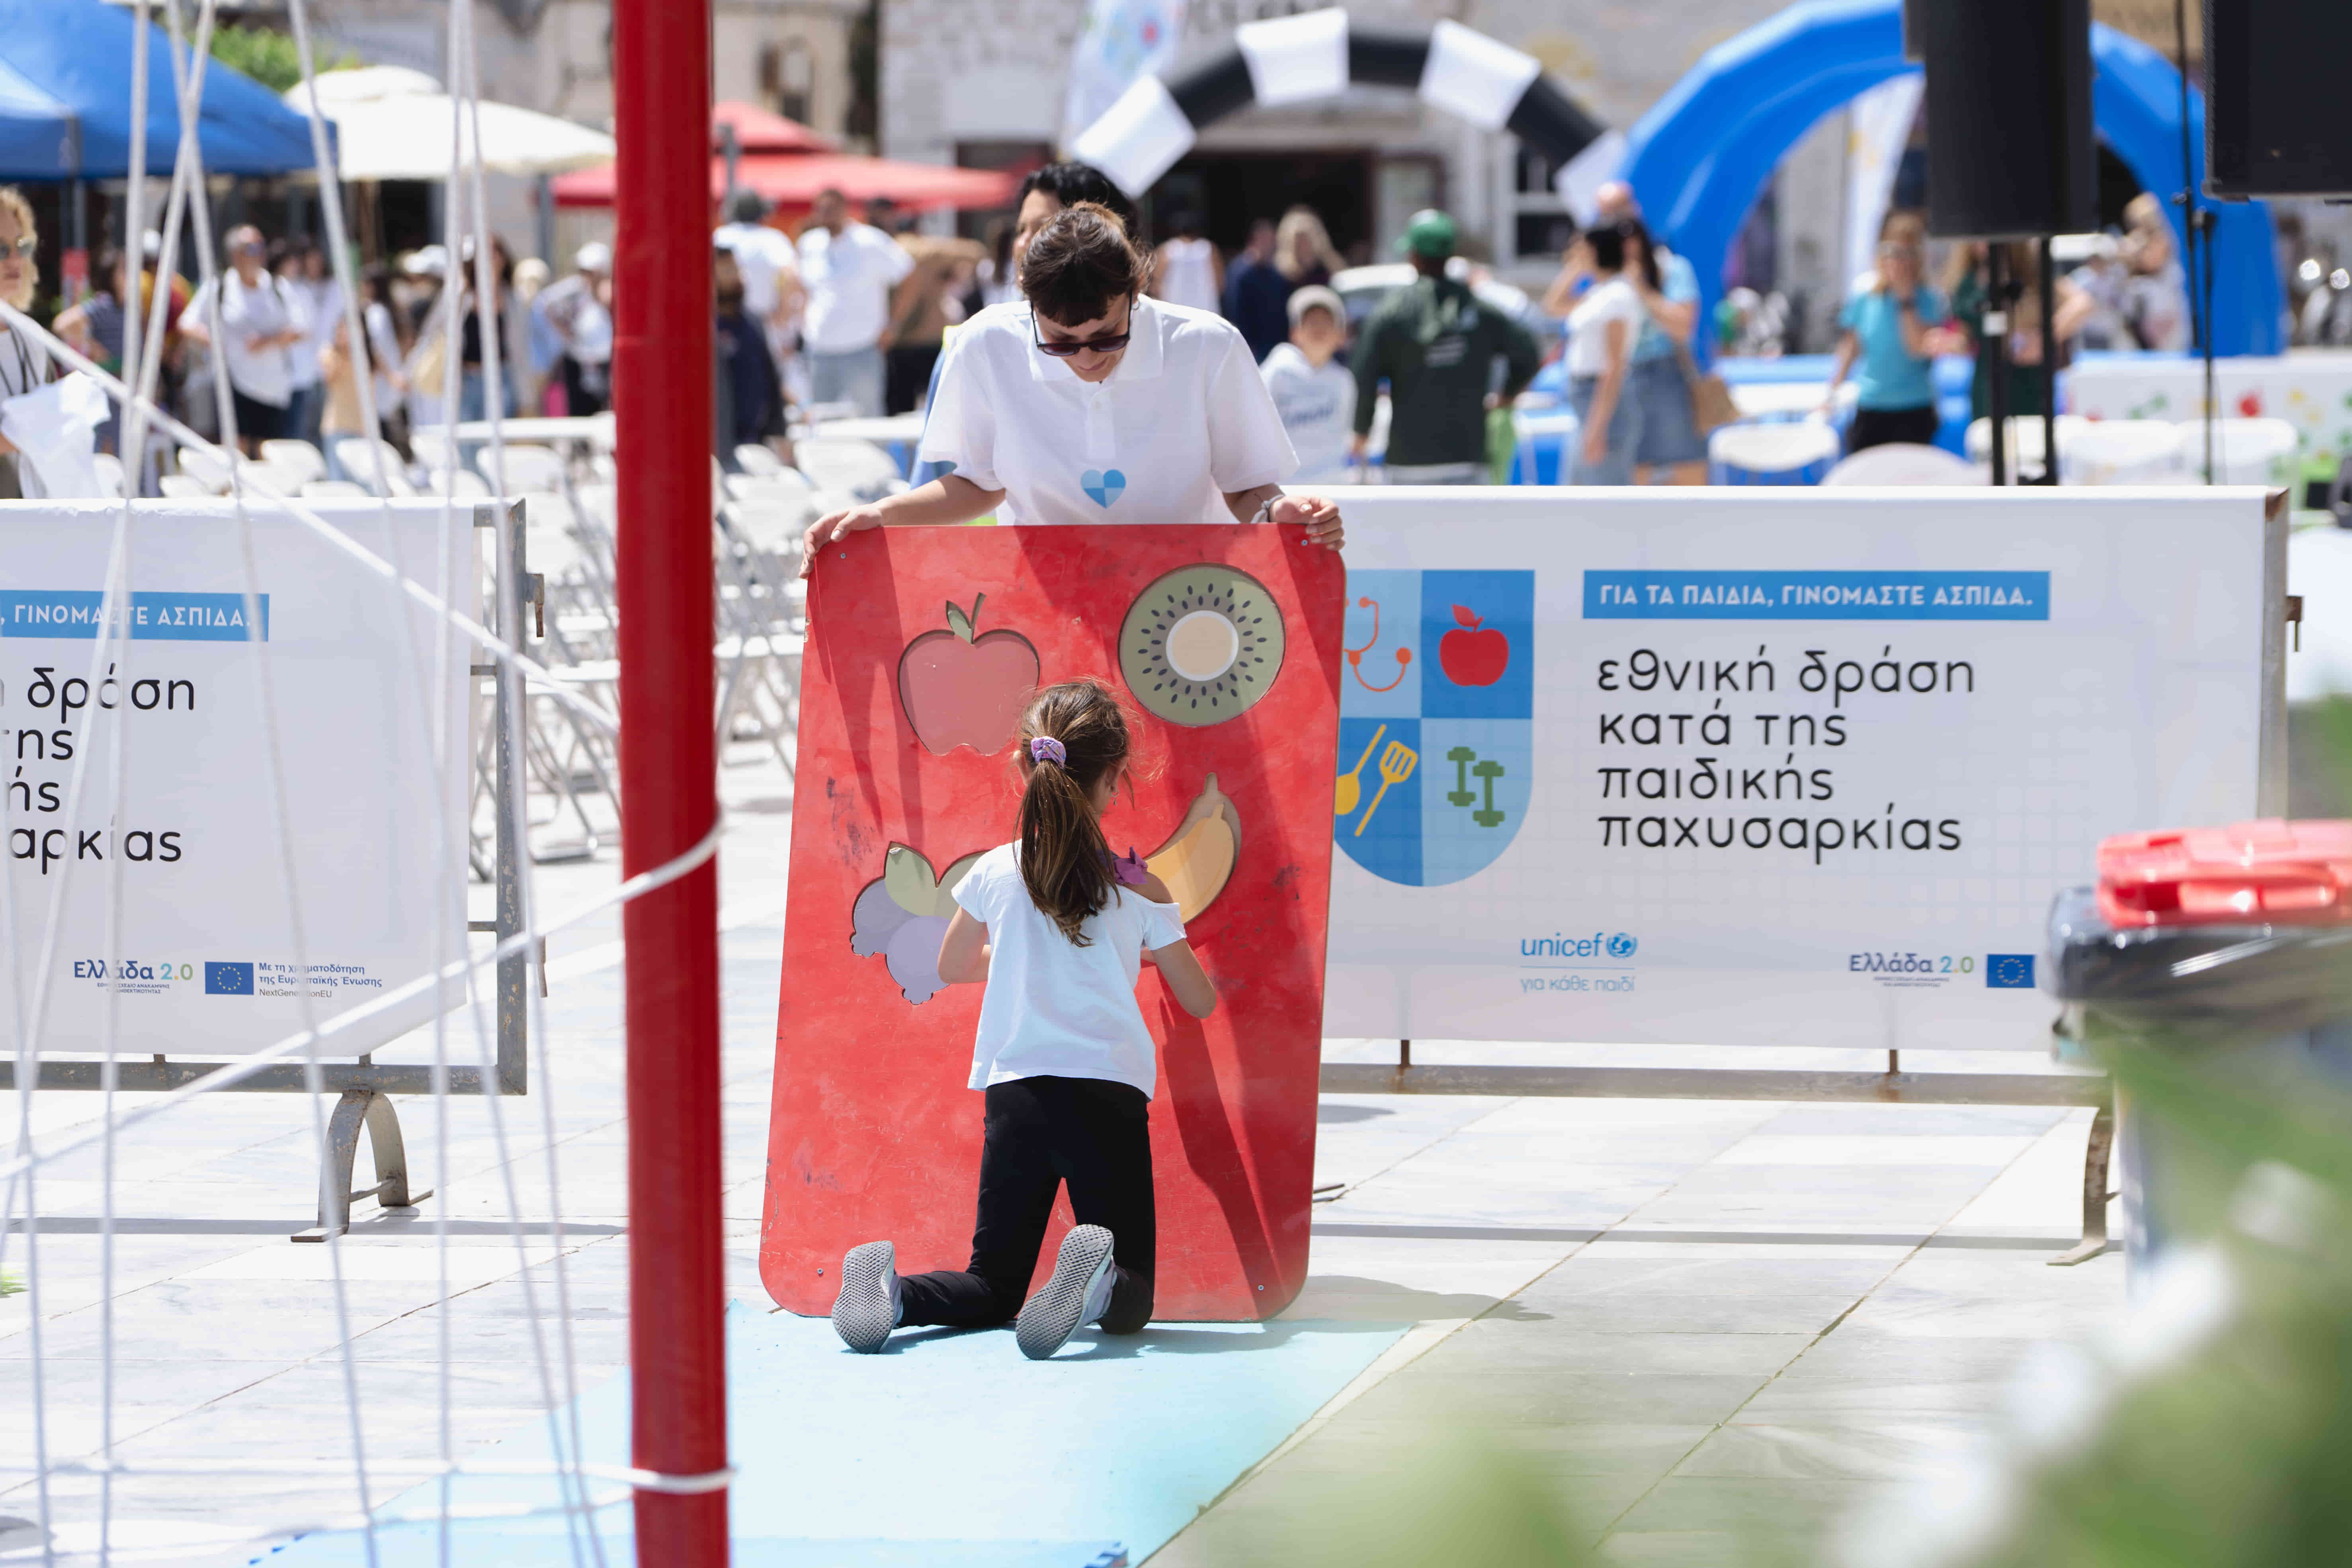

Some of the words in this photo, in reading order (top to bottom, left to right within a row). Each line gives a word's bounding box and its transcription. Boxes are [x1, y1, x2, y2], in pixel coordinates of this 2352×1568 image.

[1600, 584, 1638, 605] ΓΙΑ
[1645, 585, 1674, 605] ΤΑ
[1682, 585, 1775, 608] ΠΑΙΔΙΑ,
[1781, 585, 1925, 605] ΓΙΝΟΜΑΣΤΕ
[1932, 586, 2033, 606] ΑΣΠΙΔΑ.
[1598, 644, 1774, 692] εθνική
[1799, 644, 1974, 708] δράση
[1600, 698, 1731, 745] κατά
[1754, 714, 1848, 746] της
[1597, 752, 1834, 801] παιδικής
[1597, 802, 1961, 865] παχυσαρκίας
[1521, 931, 1604, 957] unicef
[160, 963, 194, 980] 2.0
[258, 962, 272, 971] Με
[274, 964, 285, 973] τη
[1850, 951, 1934, 973] Ελλάδα
[1940, 955, 1976, 974] 2.0
[258, 975, 275, 985] της
[277, 974, 338, 987] Ευρπαϊκής
[340, 976, 383, 988] Ένωσης
[1519, 978, 1545, 994] για
[1549, 974, 1590, 992] κάθε
